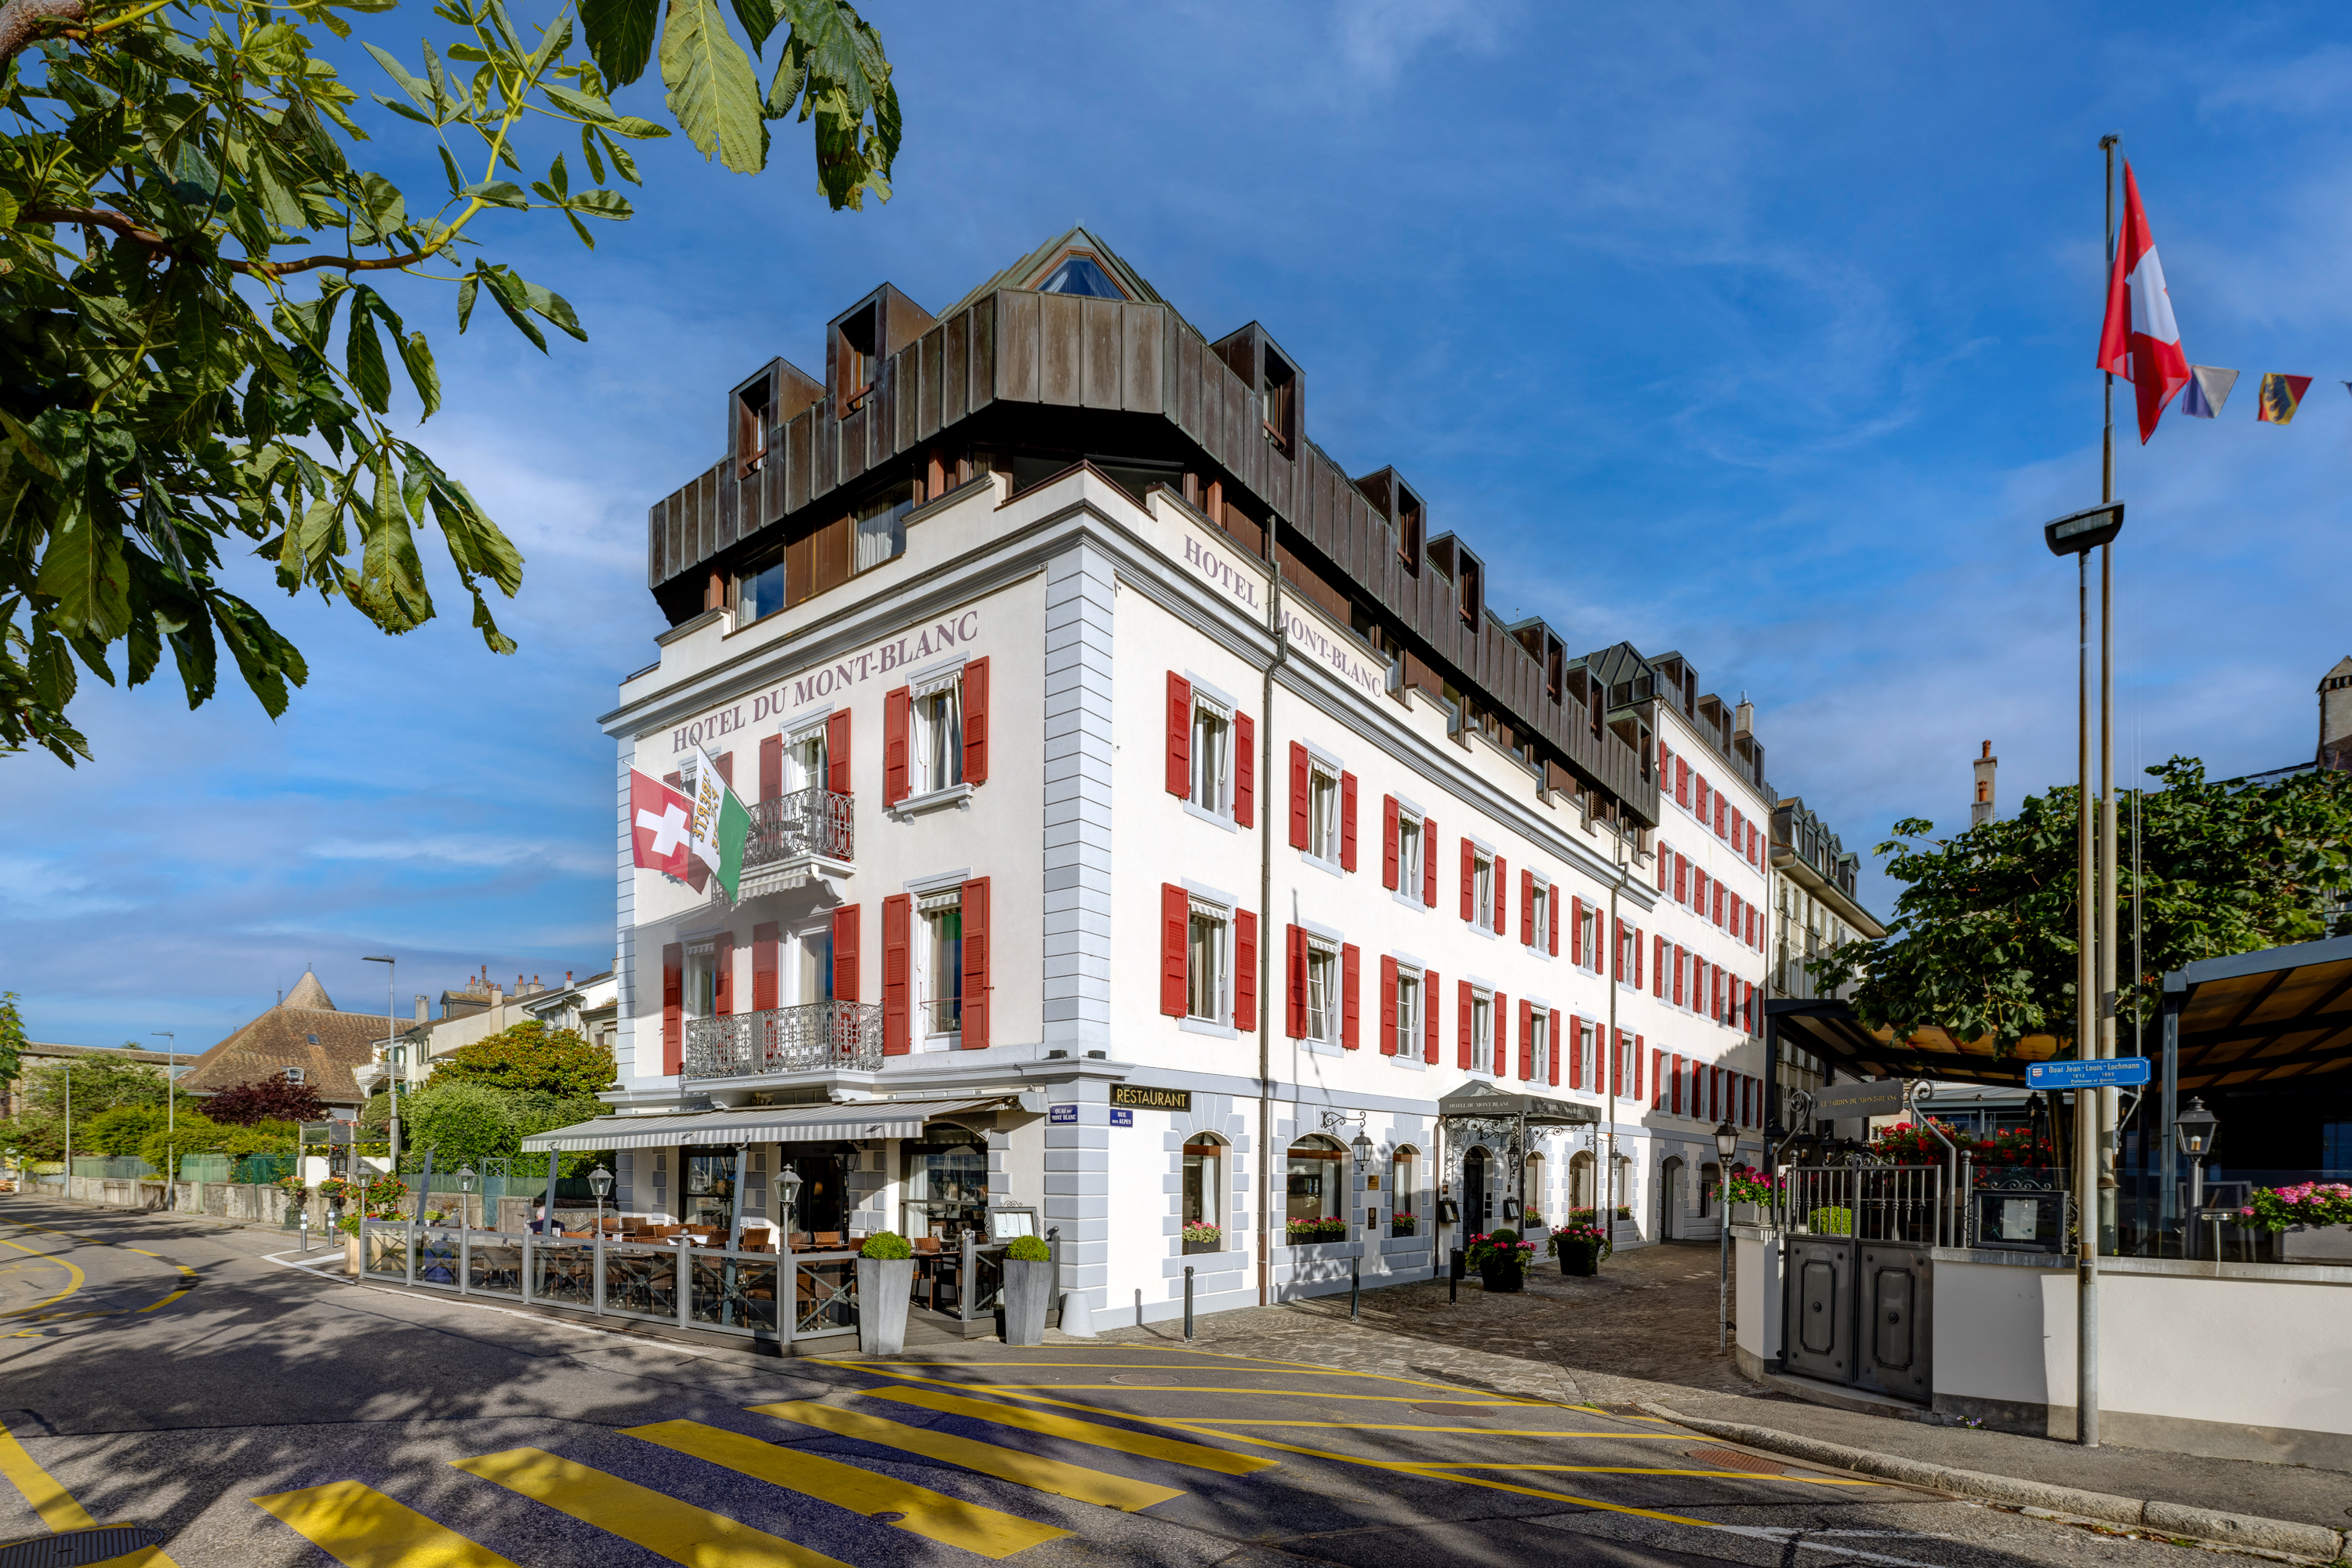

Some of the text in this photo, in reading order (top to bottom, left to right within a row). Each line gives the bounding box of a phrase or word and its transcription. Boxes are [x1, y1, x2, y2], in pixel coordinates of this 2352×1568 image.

[1184, 534, 1381, 698] HOTEL MONT-BLANC
[672, 611, 978, 753] HOTEL DU MONT-BLANC
[1116, 1088, 1186, 1107] RESTAURANT
[1860, 1094, 1897, 1104] MONT-BLANC
